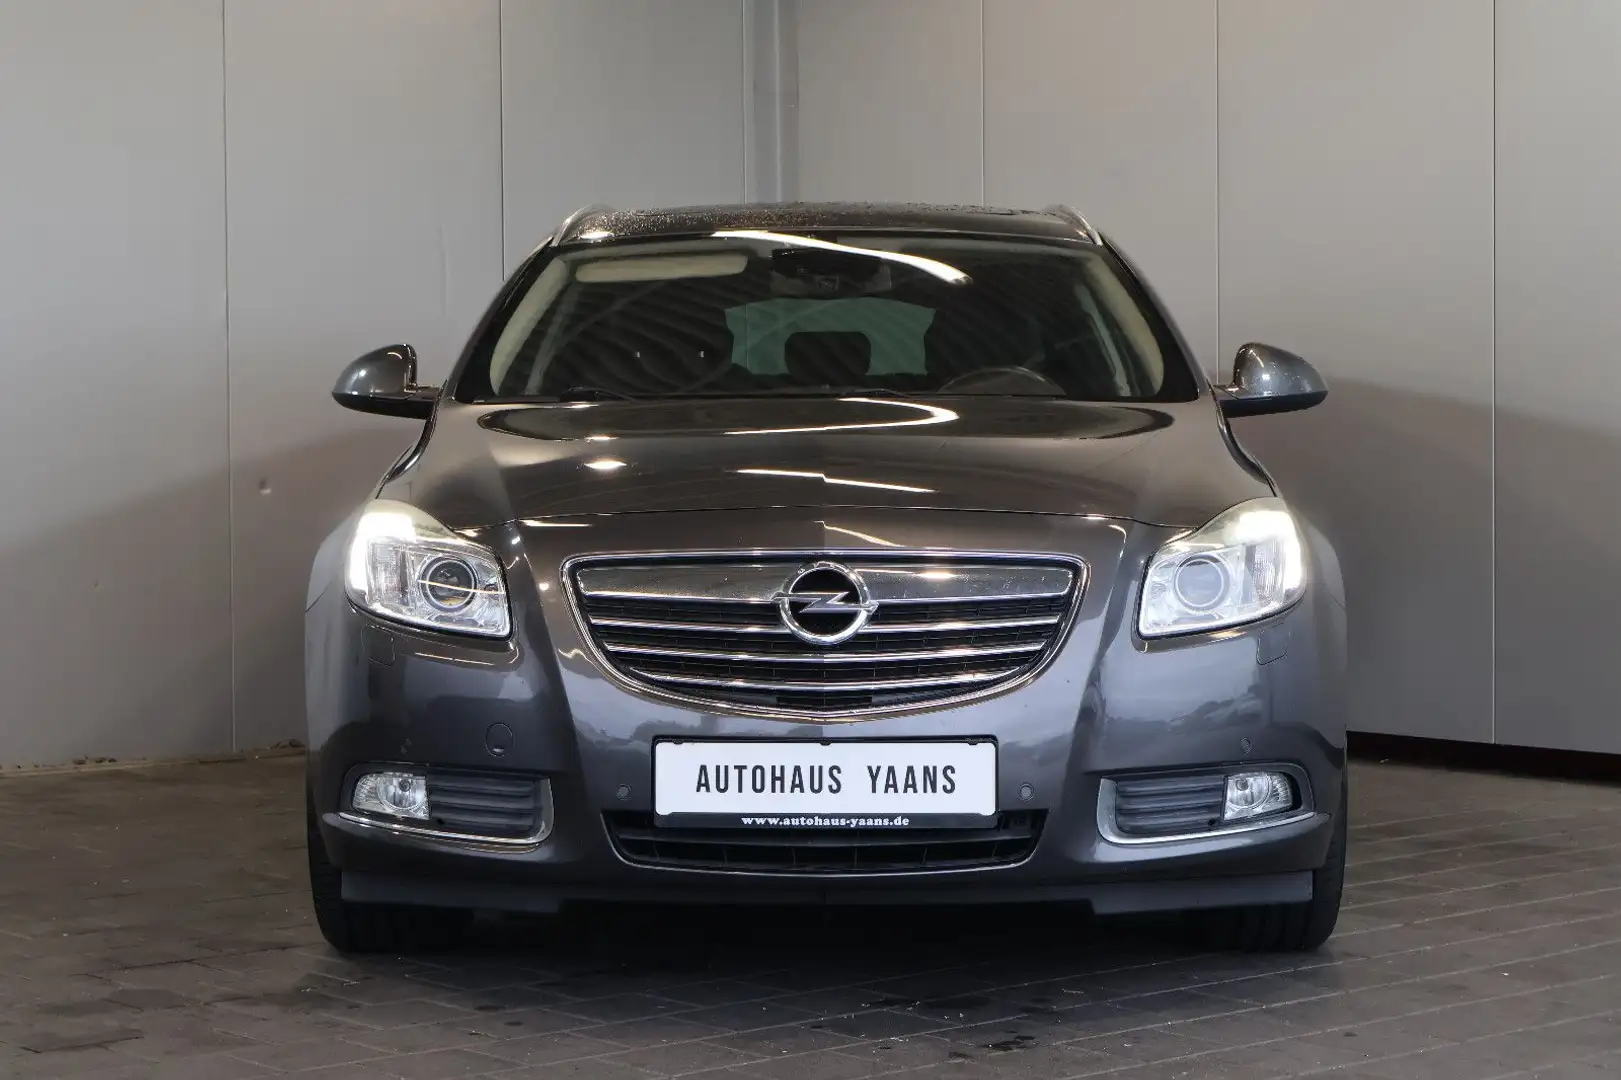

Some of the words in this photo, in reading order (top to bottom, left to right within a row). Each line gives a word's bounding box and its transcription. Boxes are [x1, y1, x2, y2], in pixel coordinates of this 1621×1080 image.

[695, 764, 842, 795] AUTOHAUS
[867, 764, 956, 795] YAANS
[740, 815, 910, 828] www.autohaus-yaans.de
